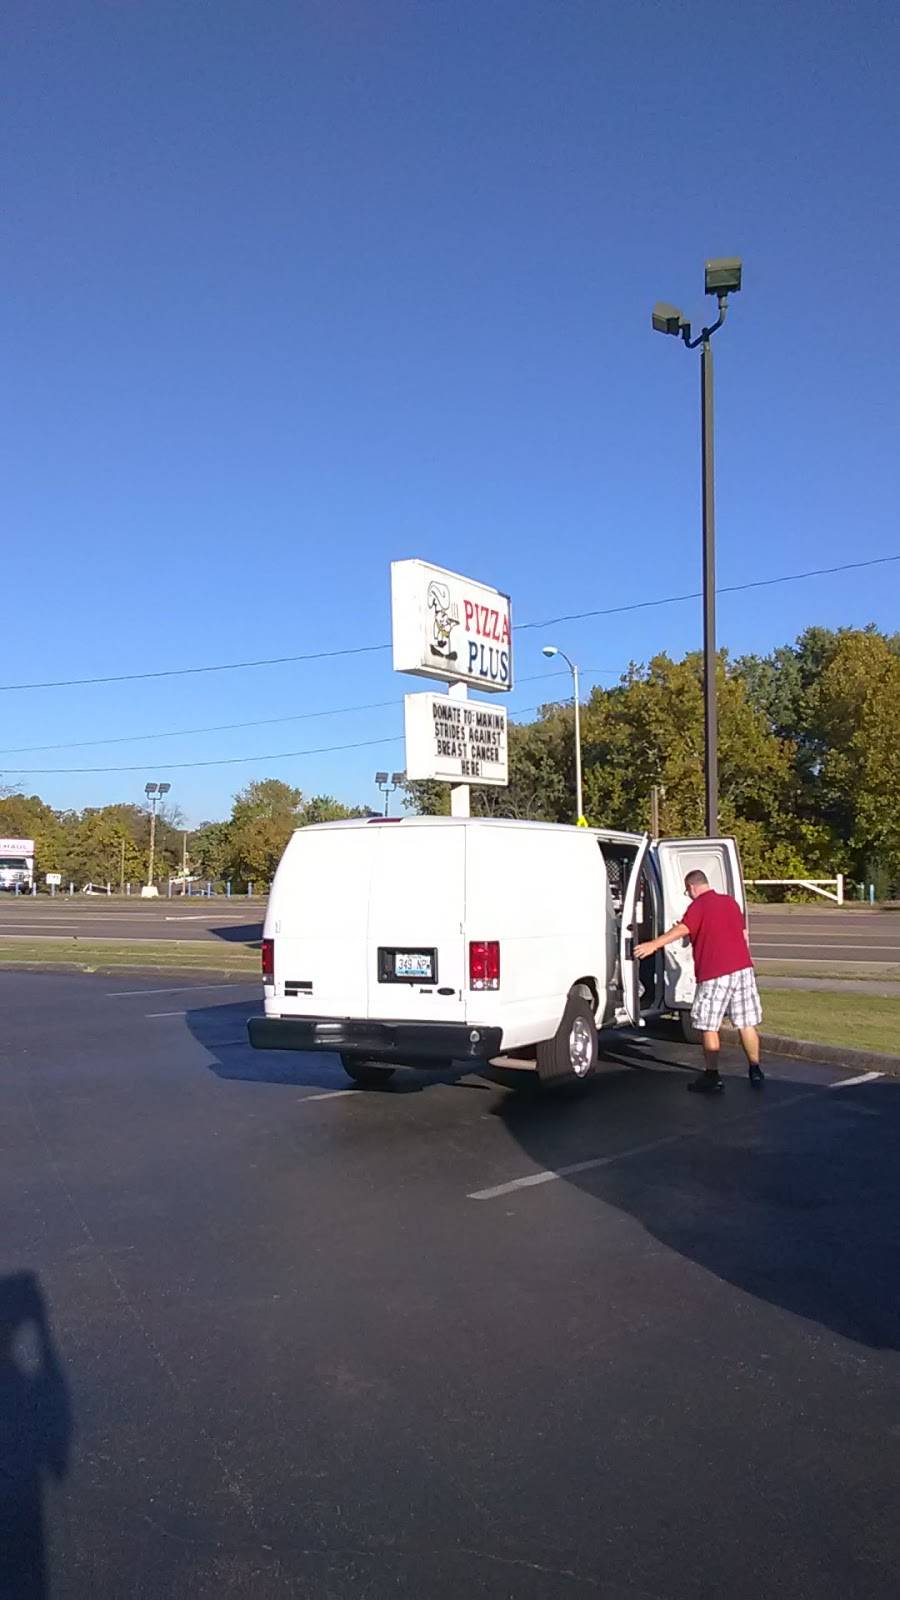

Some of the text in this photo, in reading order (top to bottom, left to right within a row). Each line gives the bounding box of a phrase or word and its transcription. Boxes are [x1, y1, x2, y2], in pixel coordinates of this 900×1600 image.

[463, 599, 511, 645] PIZZA
[468, 640, 509, 682] PLUS
[432, 702, 461, 723] DONATE
[434, 722, 501, 746] STRIDES AGAINST
[437, 739, 499, 762] BREAST CANCER
[461, 760, 480, 776] HERE
